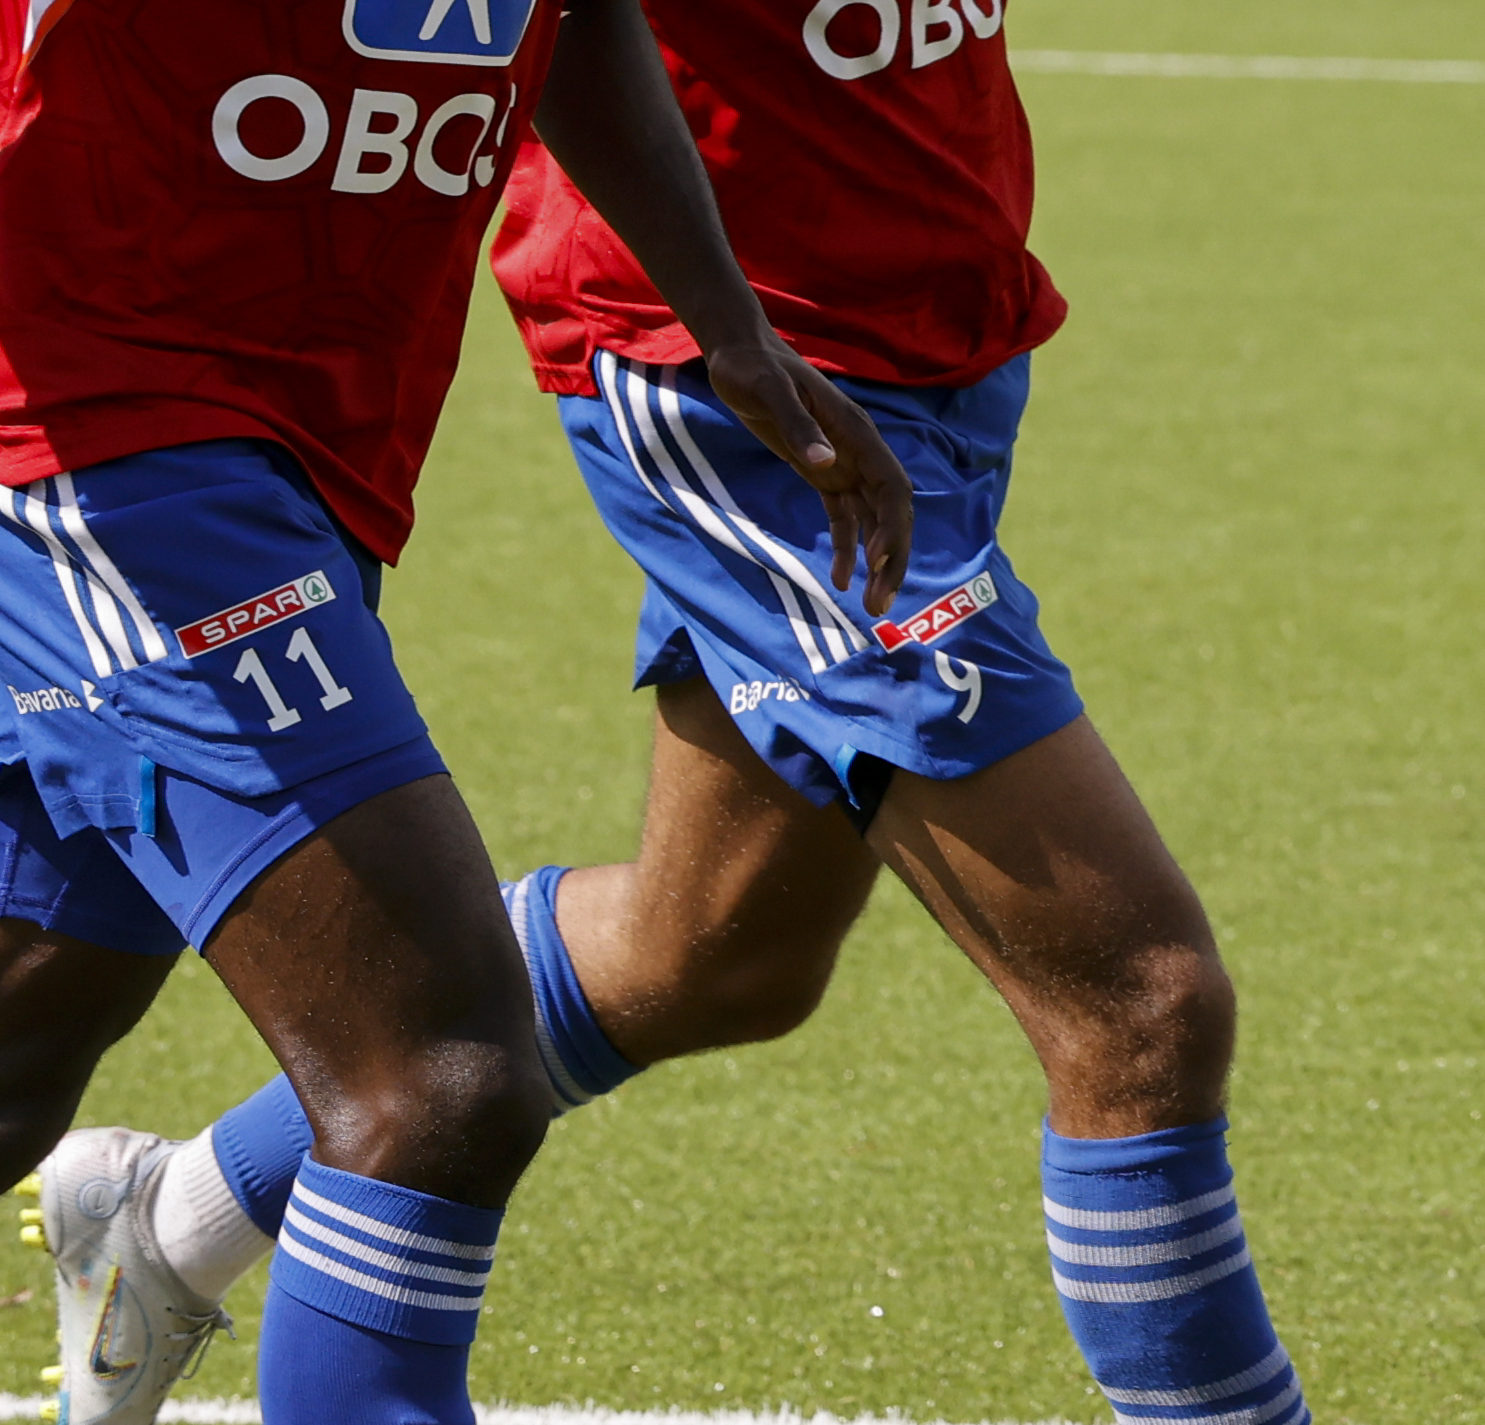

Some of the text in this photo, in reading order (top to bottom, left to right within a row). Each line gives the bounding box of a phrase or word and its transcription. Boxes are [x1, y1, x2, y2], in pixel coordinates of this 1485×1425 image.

[201, 589, 302, 644] SPAR
[901, 593, 975, 643] PAR
[232, 626, 354, 733] 11
[934, 649, 983, 725] 9
